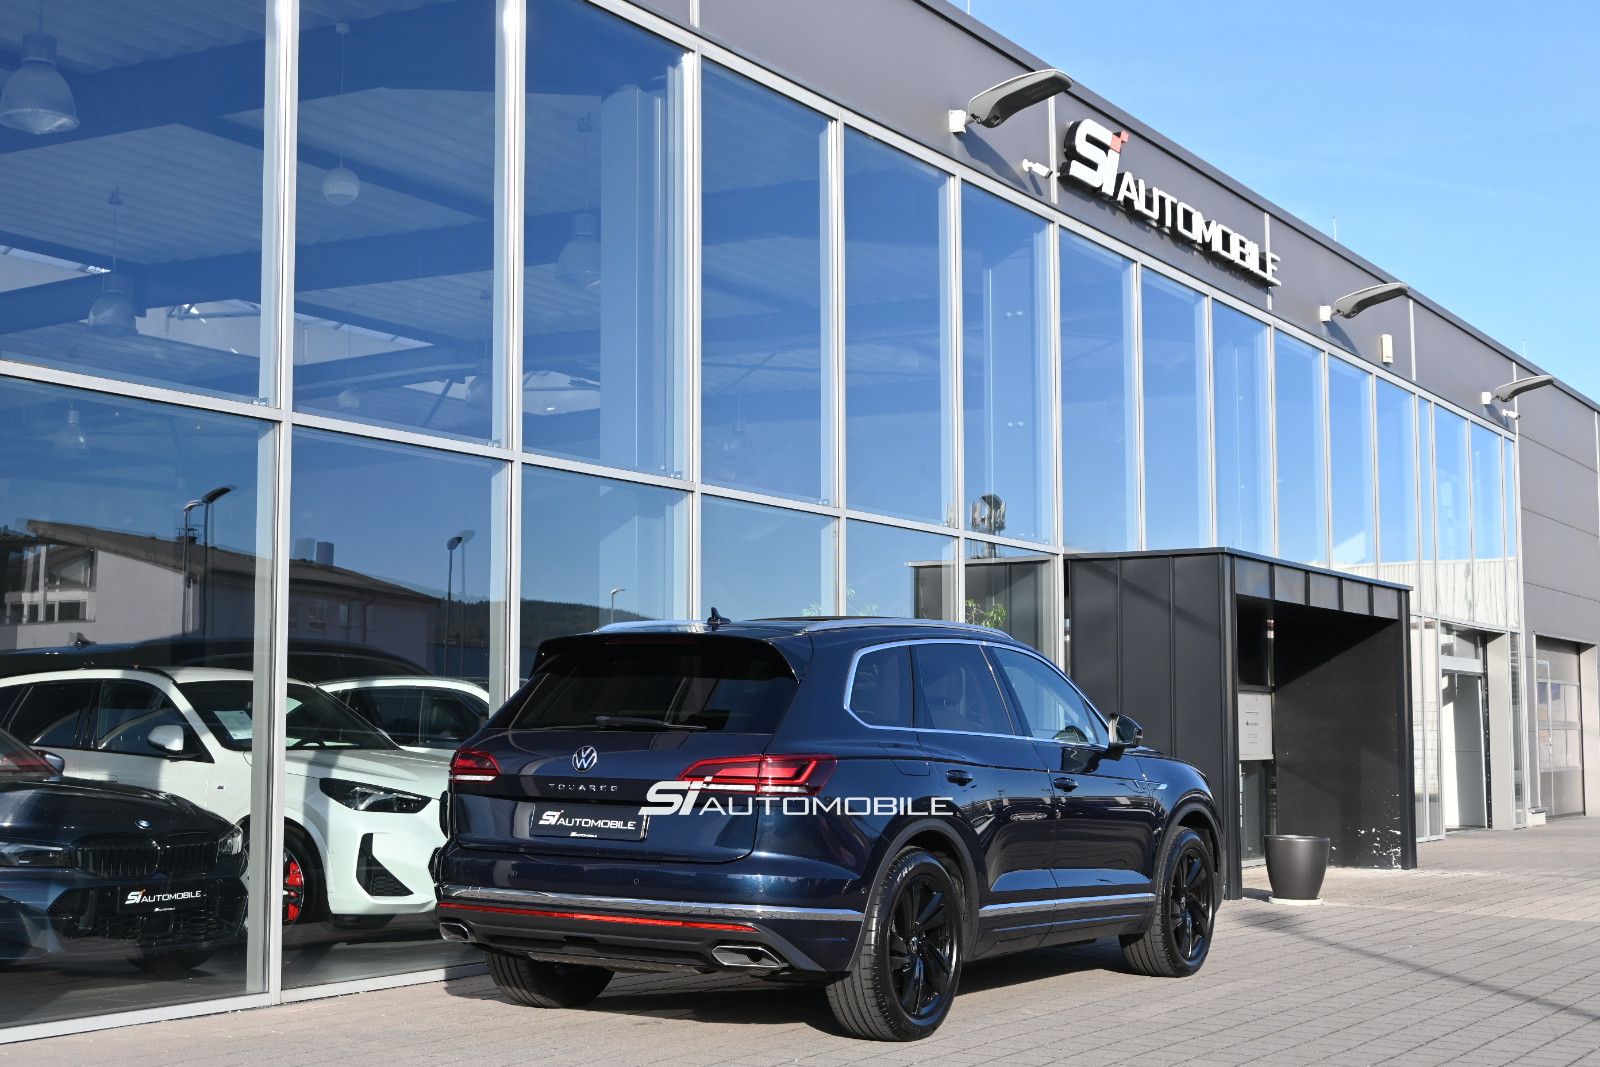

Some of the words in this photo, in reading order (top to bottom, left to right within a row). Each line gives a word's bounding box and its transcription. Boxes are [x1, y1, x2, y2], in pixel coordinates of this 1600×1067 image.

[1117, 171, 1282, 287] AUTOMOBILE
[557, 818, 637, 830] AUTOMOBILE
[141, 890, 202, 903] AUTOMOBILE
